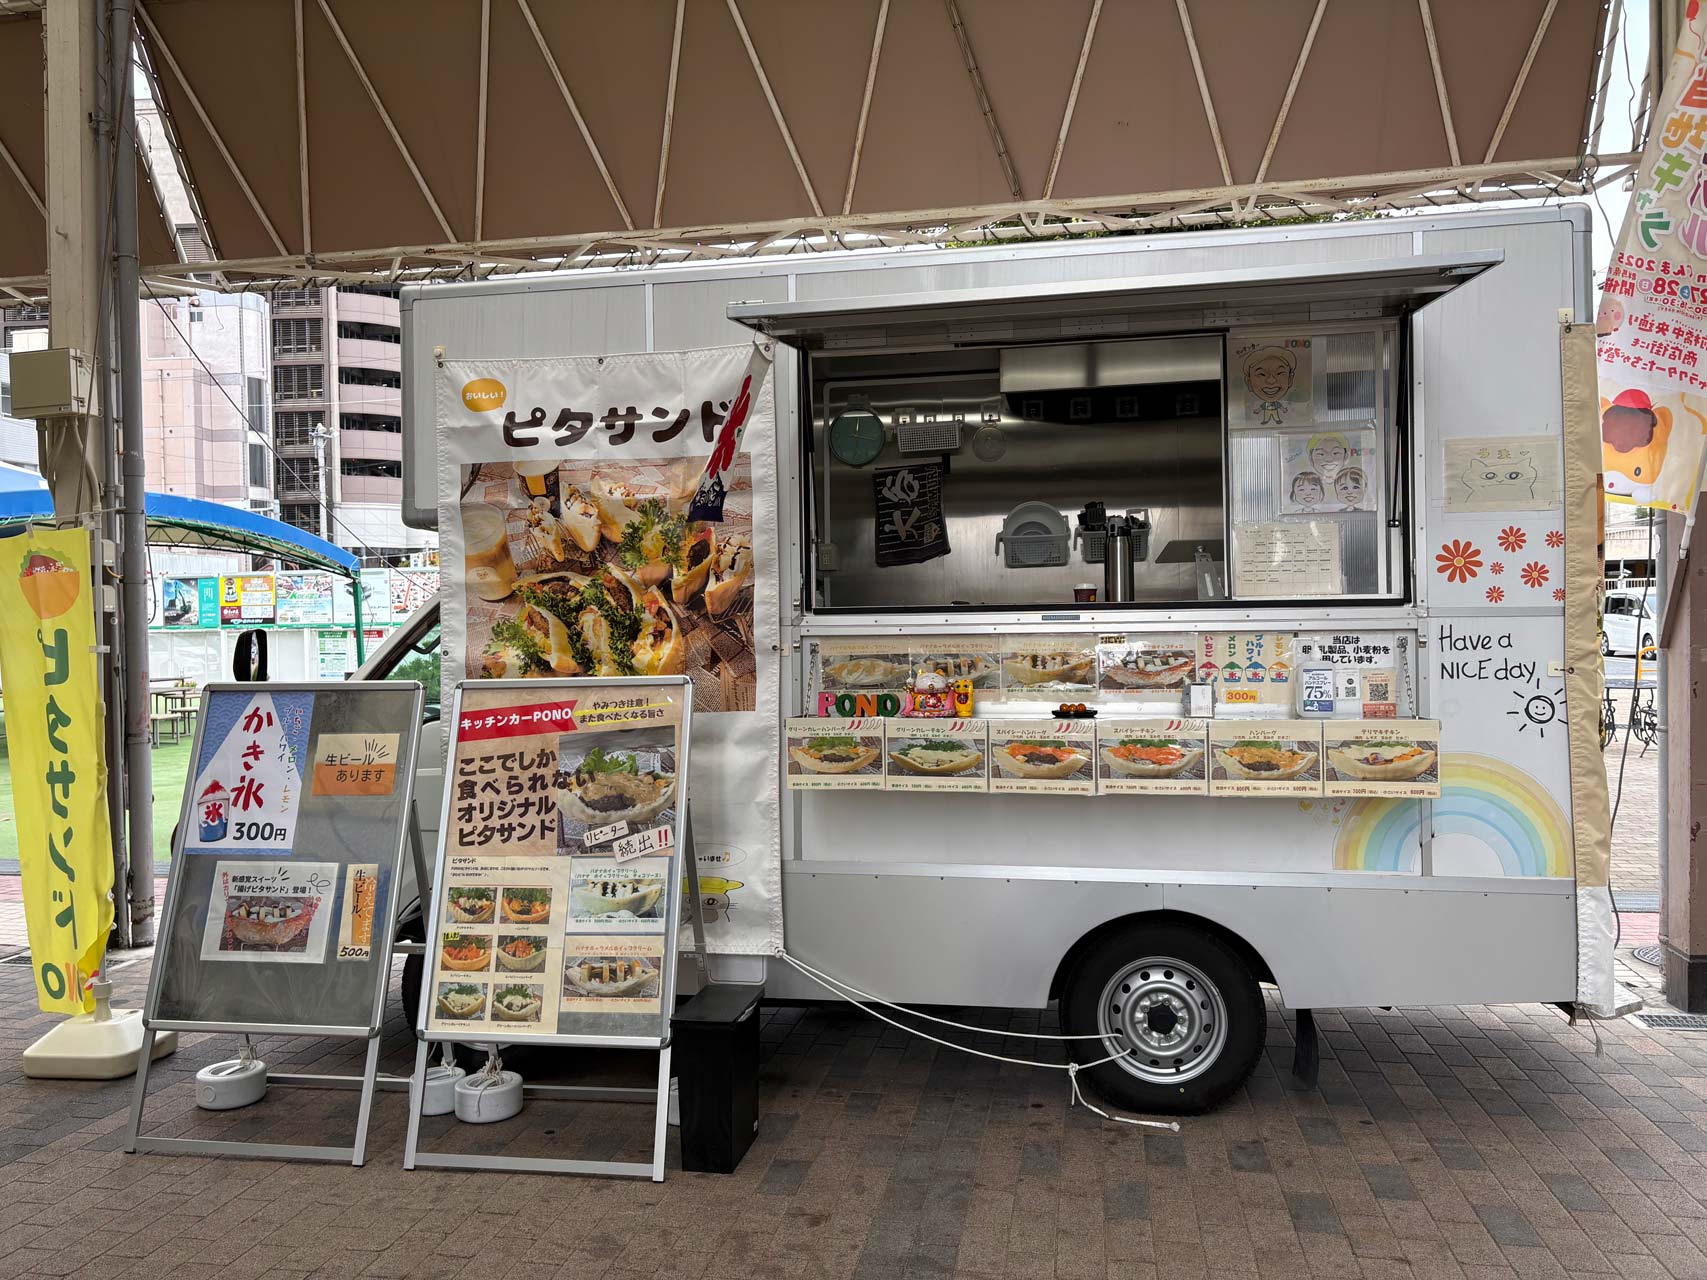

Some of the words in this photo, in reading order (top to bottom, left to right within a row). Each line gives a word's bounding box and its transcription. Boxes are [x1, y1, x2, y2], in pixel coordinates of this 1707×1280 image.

[465, 391, 505, 400] おいしい！
[502, 400, 734, 448] ピタサンド
[1204, 635, 1214, 658] いちご
[1228, 635, 1237, 658] メロン
[1255, 634, 1264, 656] ブルー
[1275, 635, 1284, 657] レモン
[1333, 636, 1361, 645] 当店は
[1438, 623, 1492, 652] Have
[1497, 633, 1513, 648] a
[1246, 640, 1254, 662] ハワイ
[1319, 655, 1378, 664] 用しています。
[1441, 658, 1492, 680] NICE
[1494, 658, 1537, 684] day
[1227, 691, 1256, 701] 300円
[1305, 686, 1332, 699] 75%
[579, 708, 665, 723] また食べたくなる旨さ
[592, 698, 650, 711] やみつき注意！
[817, 691, 900, 718] PONO
[460, 707, 572, 730] キッチンカーPONO
[230, 705, 274, 812] かき氷
[325, 752, 376, 767] 生ビール
[458, 748, 557, 777] ここでしか
[336, 768, 385, 783] あります
[457, 768, 596, 801] 食べられない
[204, 802, 224, 823] 氷
[457, 795, 556, 824] オリジナル
[232, 822, 287, 841] 300円
[458, 818, 555, 847] ピタサンド
[586, 825, 625, 845] リピーター
[231, 875, 278, 884] 新感覚スイーツ
[339, 946, 370, 958] 500円
